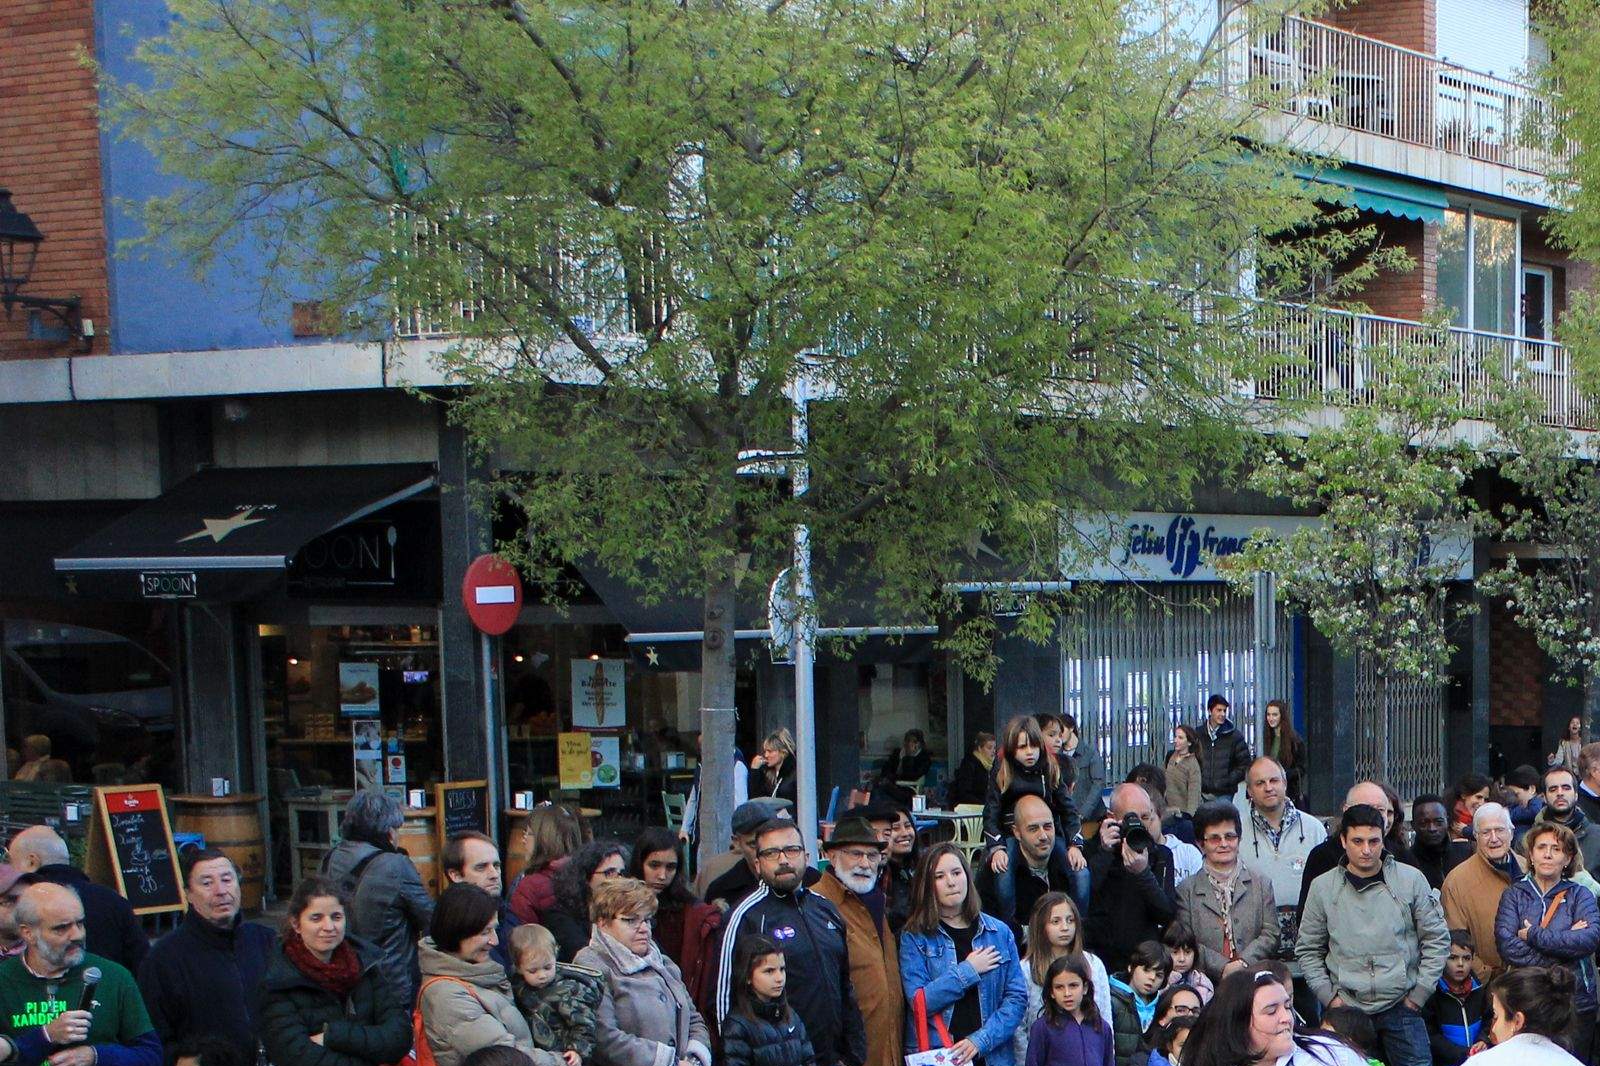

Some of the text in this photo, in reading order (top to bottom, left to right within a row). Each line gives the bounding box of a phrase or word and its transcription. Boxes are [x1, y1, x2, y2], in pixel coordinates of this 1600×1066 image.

[146, 576, 191, 592] SPOON
[26, 1000, 67, 1013] PI D'EN
